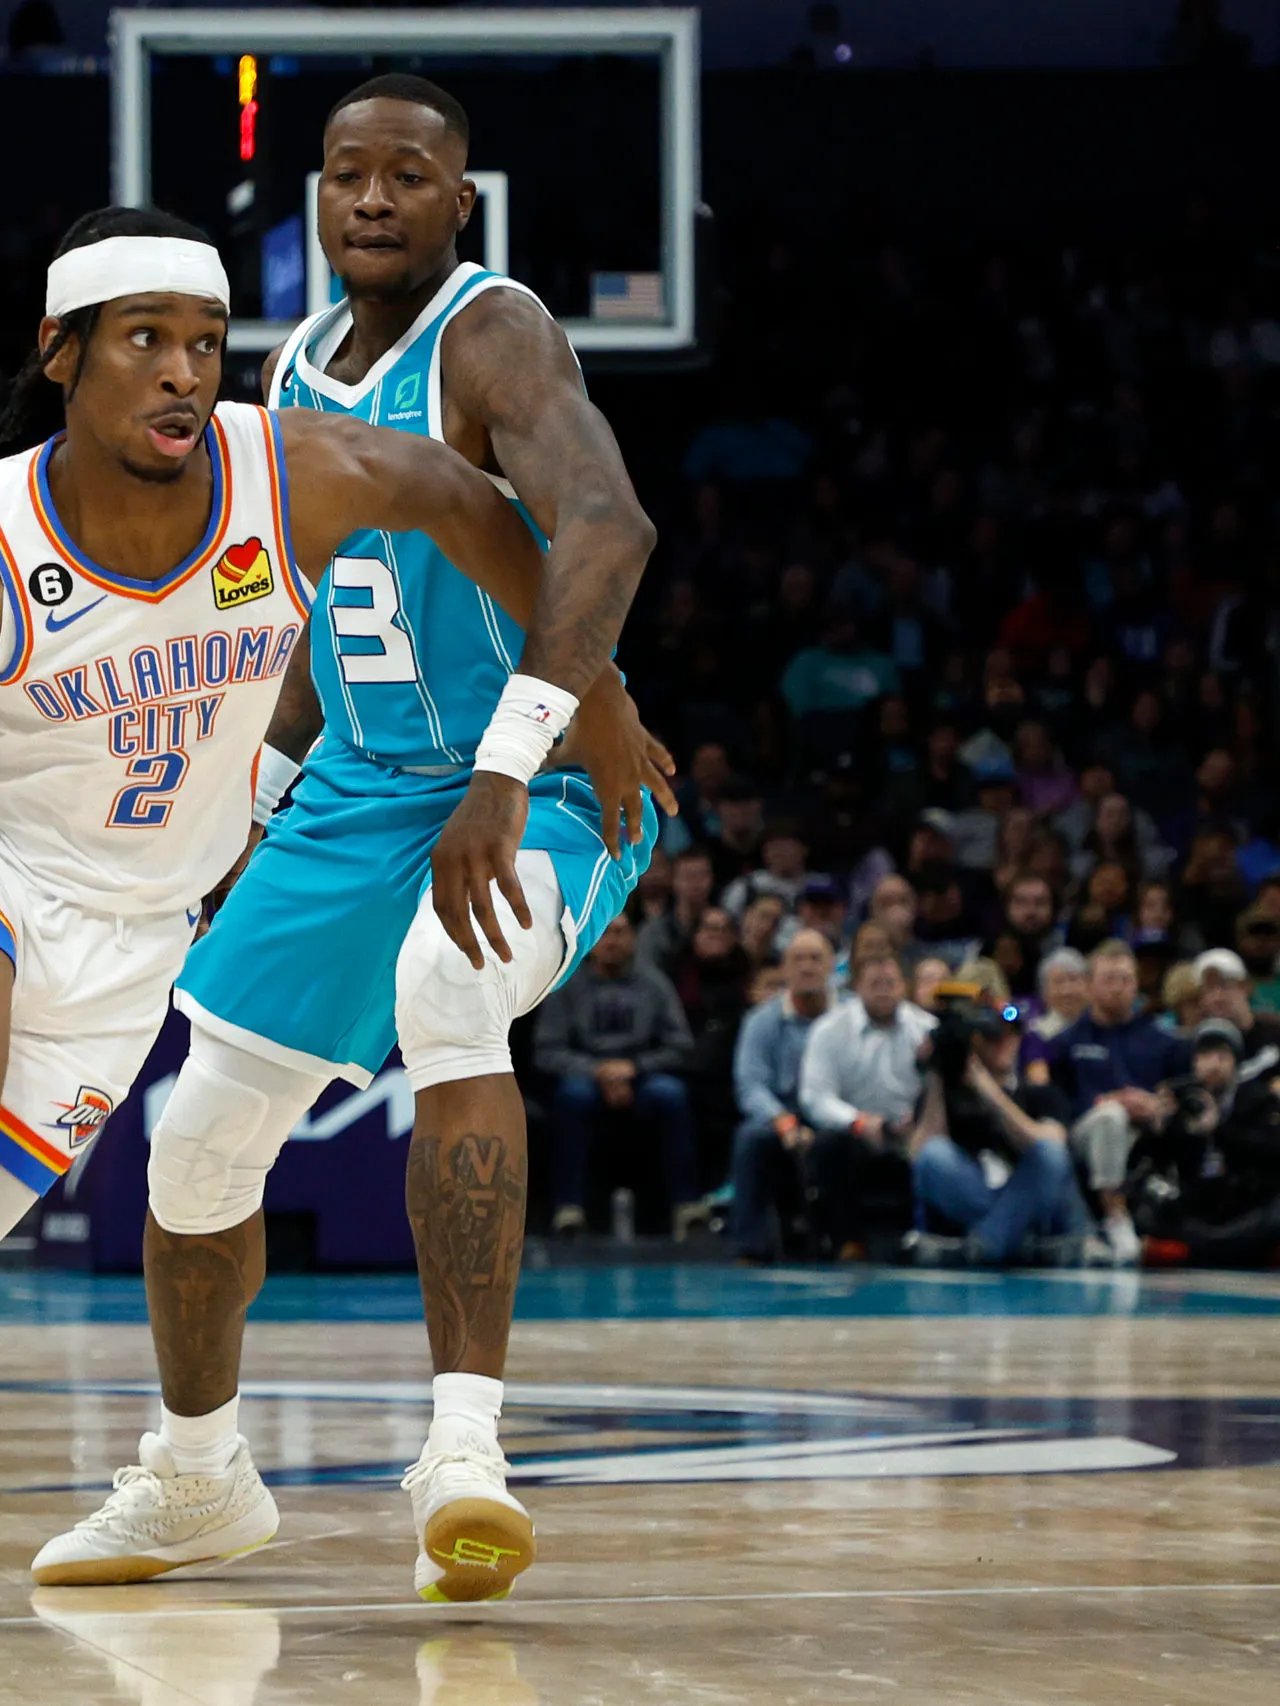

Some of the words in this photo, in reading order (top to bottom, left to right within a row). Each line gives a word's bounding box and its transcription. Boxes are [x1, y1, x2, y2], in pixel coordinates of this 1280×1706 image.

[38, 568, 64, 602] 6
[330, 555, 418, 684] 3
[24, 623, 300, 722] OKLAHOMA
[109, 693, 226, 758] CITY
[105, 751, 191, 828] 2
